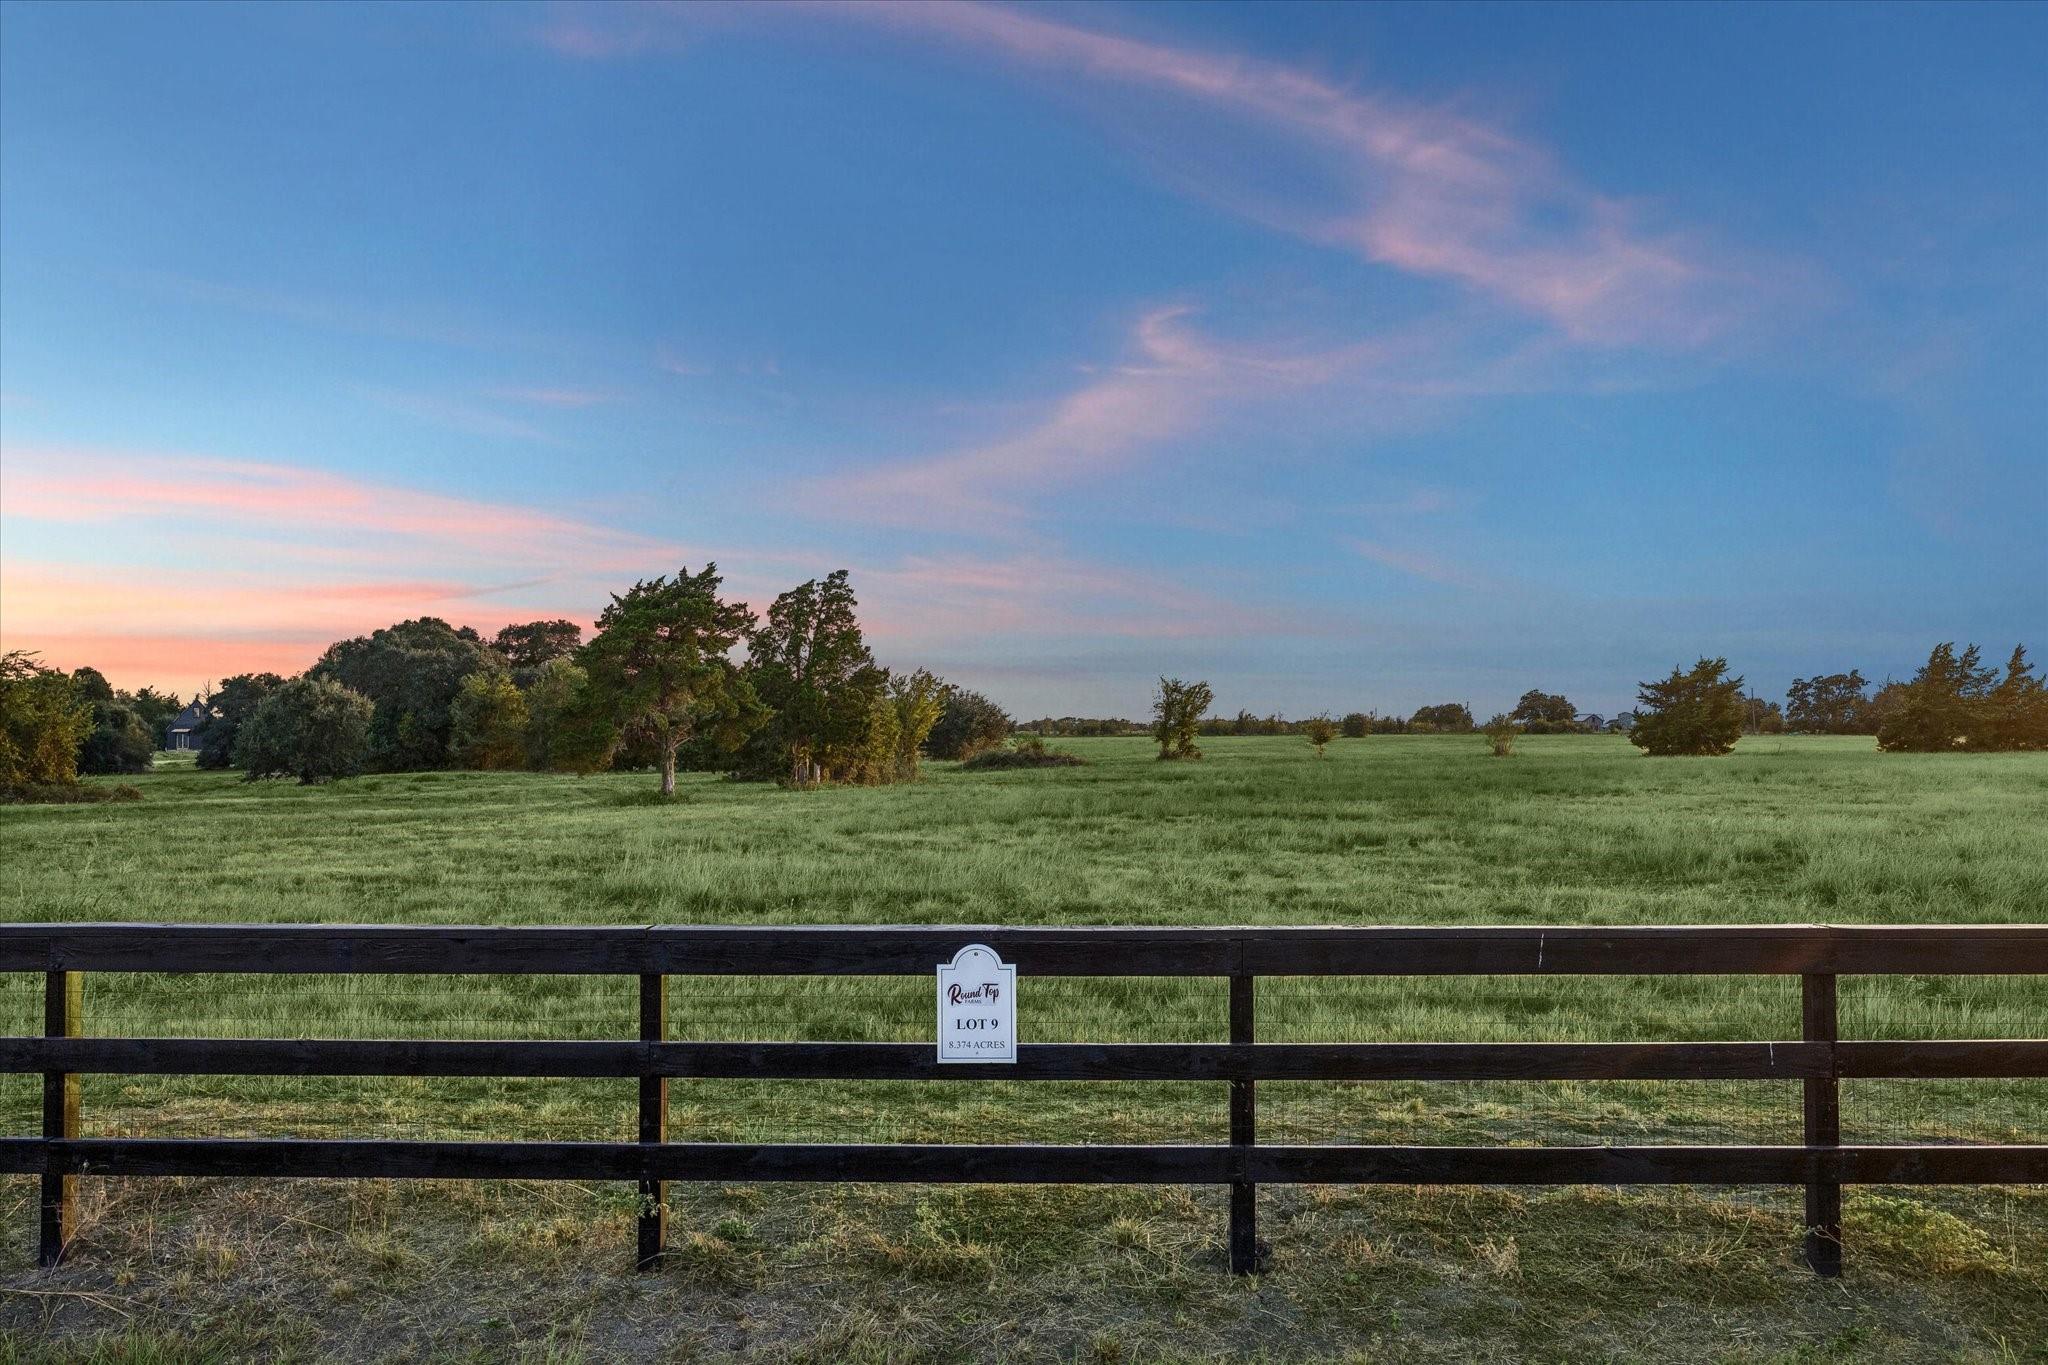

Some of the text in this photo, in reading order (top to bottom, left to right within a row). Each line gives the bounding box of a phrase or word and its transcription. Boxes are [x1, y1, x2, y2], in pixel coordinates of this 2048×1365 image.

[947, 983, 1000, 1007] Round Top
[956, 1018, 999, 1031] LOT 9
[948, 1040, 1006, 1049] 8.374 ACRES
